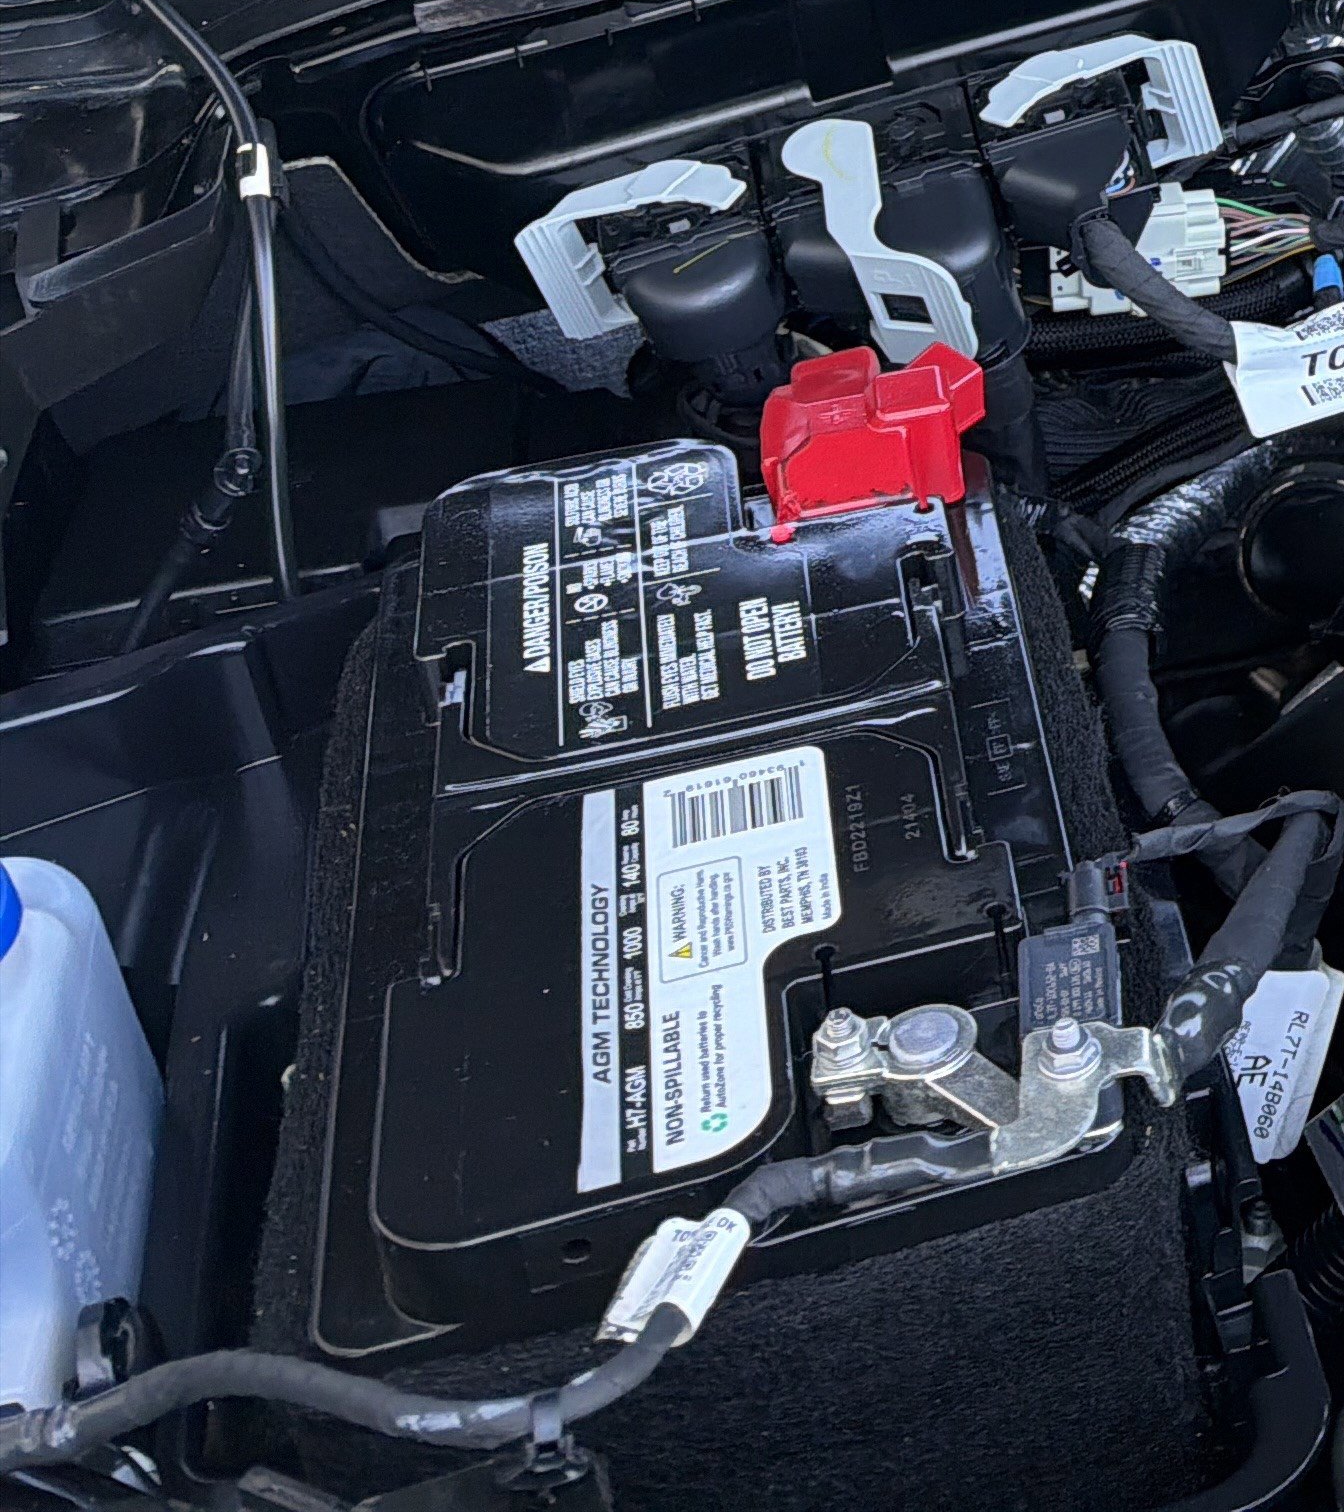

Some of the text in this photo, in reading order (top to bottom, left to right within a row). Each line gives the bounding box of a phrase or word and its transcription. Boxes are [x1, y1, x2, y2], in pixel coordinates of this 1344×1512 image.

[522, 541, 551, 659] DANGER/POISON
[695, 629, 715, 650] HELP
[738, 596, 776, 680] DO NOT OPEN
[771, 600, 806, 663] BATTERY!
[567, 658, 585, 678] EYES
[660, 661, 679, 684] EYES
[661, 682, 680, 709] FLUSH
[681, 681, 699, 704] WITH
[700, 683, 719, 700] GET
[620, 819, 639, 837] 80
[621, 861, 641, 887] 140
[797, 869, 810, 882] TN
[710, 900, 721, 916] after
[756, 864, 775, 933] DISTRIBUTED BY
[777, 855, 794, 928] BEST PARTS, INC.
[798, 881, 813, 924] MEMPHIS,
[820, 872, 831, 919] Made in India
[670, 883, 686, 943] WARNING:
[696, 888, 707, 930] Reproductive
[622, 925, 642, 960] 1000
[697, 929, 708, 943] and
[711, 916, 721, 937] hands
[697, 943, 709, 968] Cancer
[591, 879, 611, 1087] AGM TECHNOLOGY
[623, 1000, 644, 1032] 850
[696, 1009, 711, 1113] Return used batteries to
[710, 983, 726, 1109] AutoZone for proper recycling
[662, 1010, 684, 1146] NON-SPILLABLE
[1236, 1054, 1272, 1088] AE
[623, 1064, 646, 1130] H7-AGM
